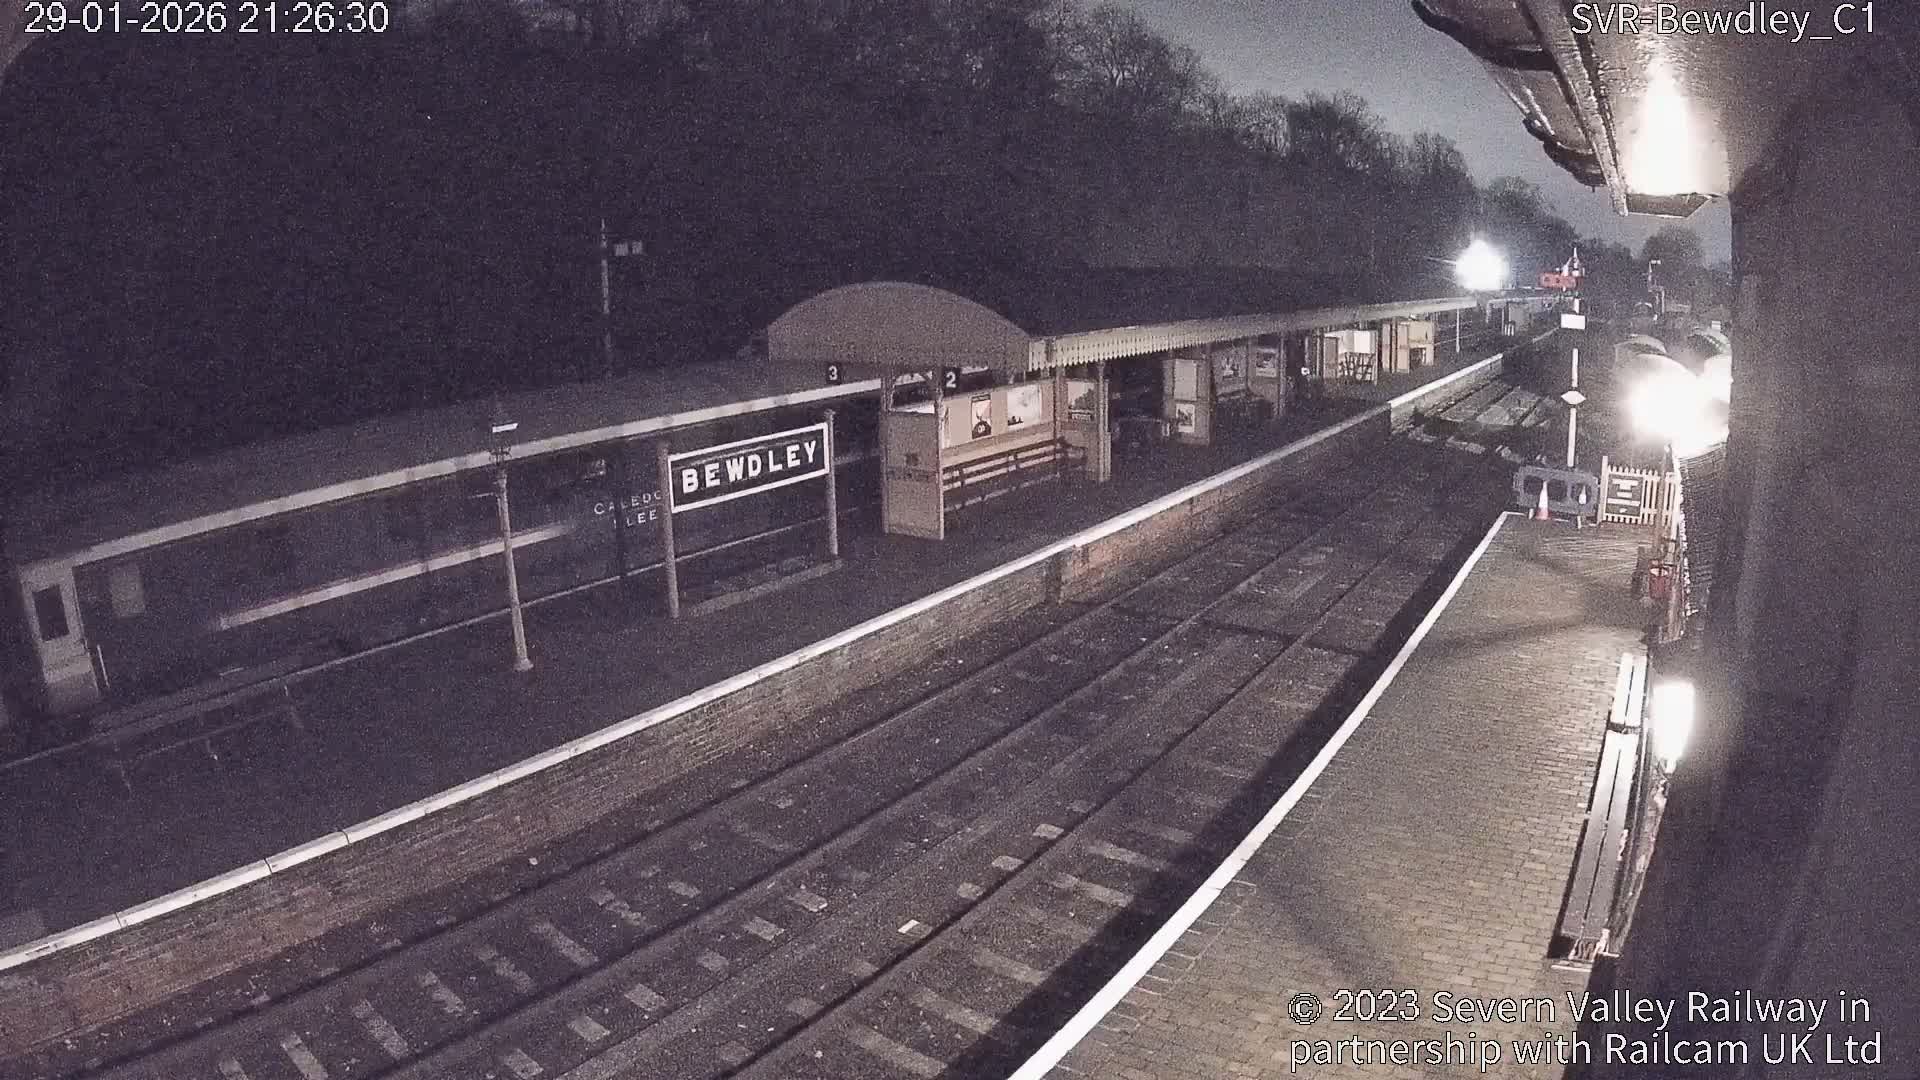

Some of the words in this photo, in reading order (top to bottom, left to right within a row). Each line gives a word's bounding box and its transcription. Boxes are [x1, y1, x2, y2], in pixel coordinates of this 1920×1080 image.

[828, 365, 838, 380] 3
[945, 371, 957, 388] 2
[681, 440, 817, 494] BEWDLEY
